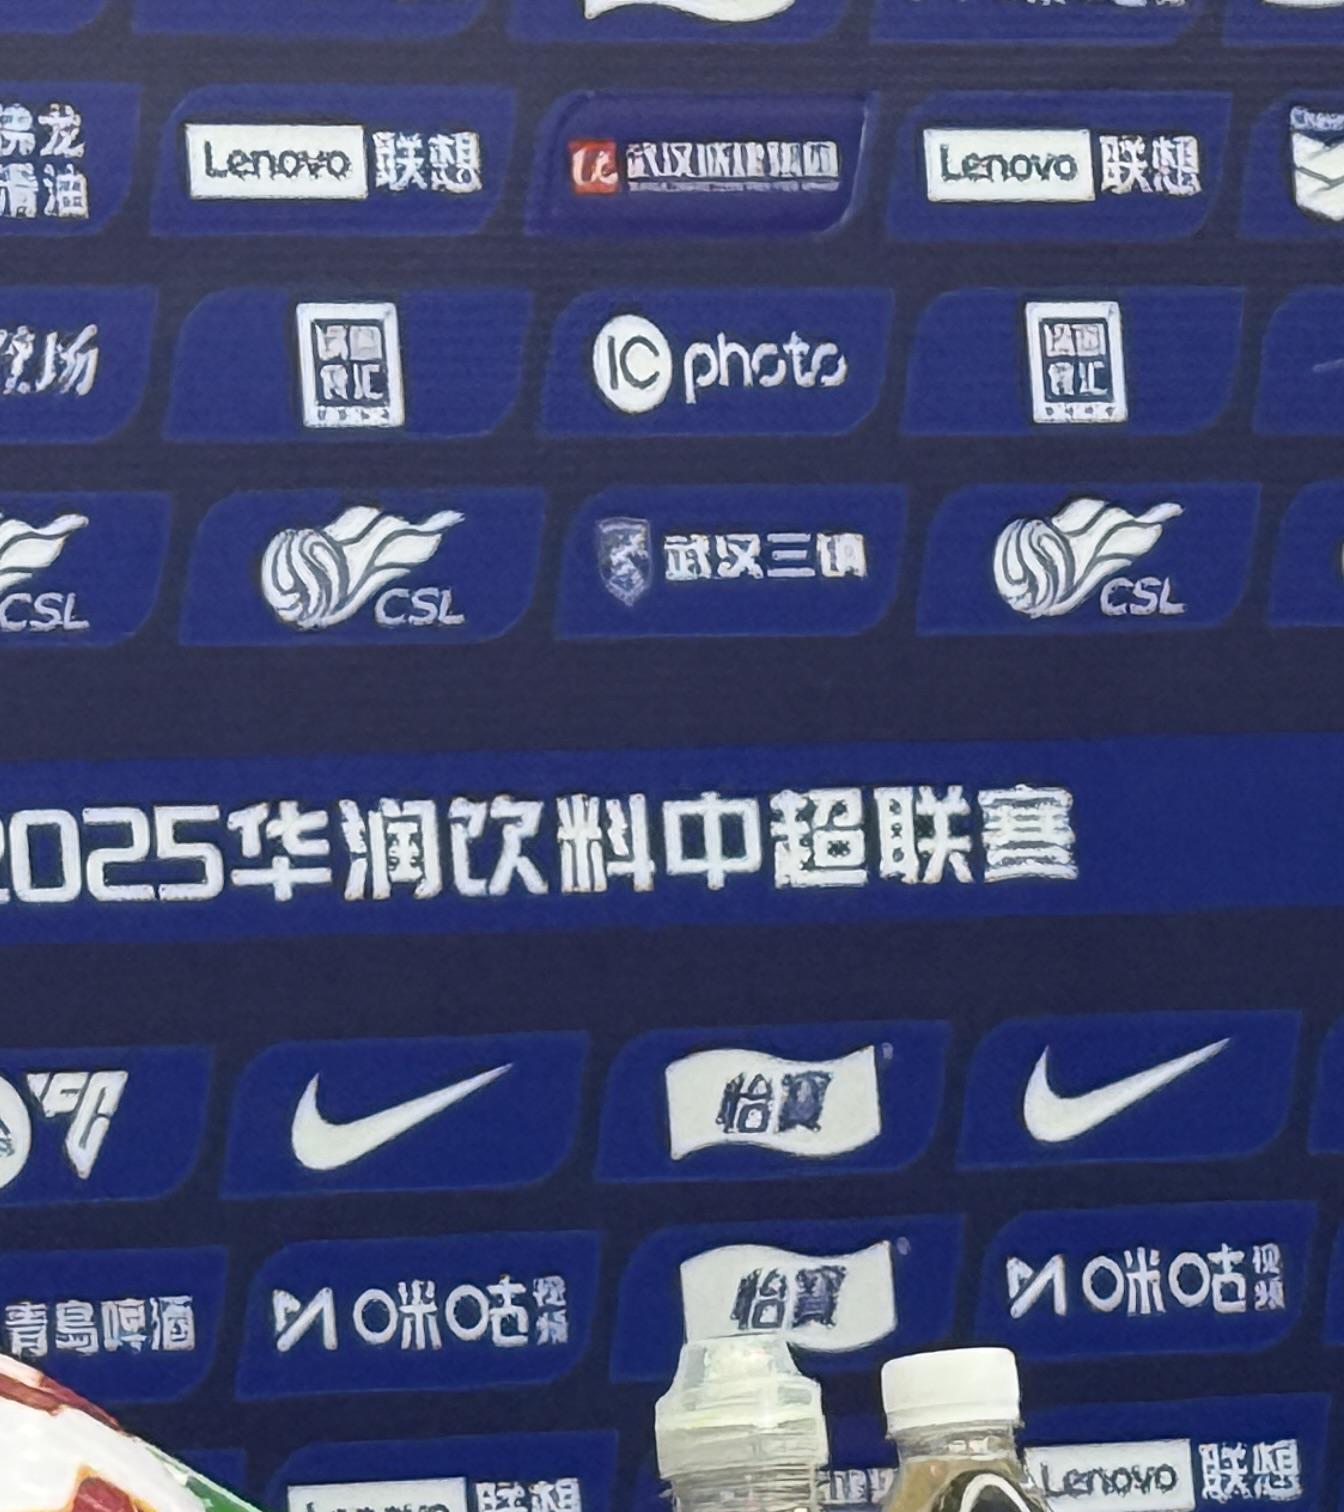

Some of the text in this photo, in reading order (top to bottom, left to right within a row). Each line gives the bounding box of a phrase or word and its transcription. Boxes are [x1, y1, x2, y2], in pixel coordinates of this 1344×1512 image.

[204, 141, 351, 180] Lenovo
[940, 145, 1077, 182] Lenovo
[607, 332, 846, 403] IC photo
[375, 586, 465, 626] CSL
[1099, 576, 1185, 616] CSL
[1082, 1244, 1246, 1314] 咪咕
[5, 1296, 195, 1357] 青岛啤酒
[353, 1276, 528, 1349] 咪咕
[1042, 1463, 1178, 1497] Lenovo
